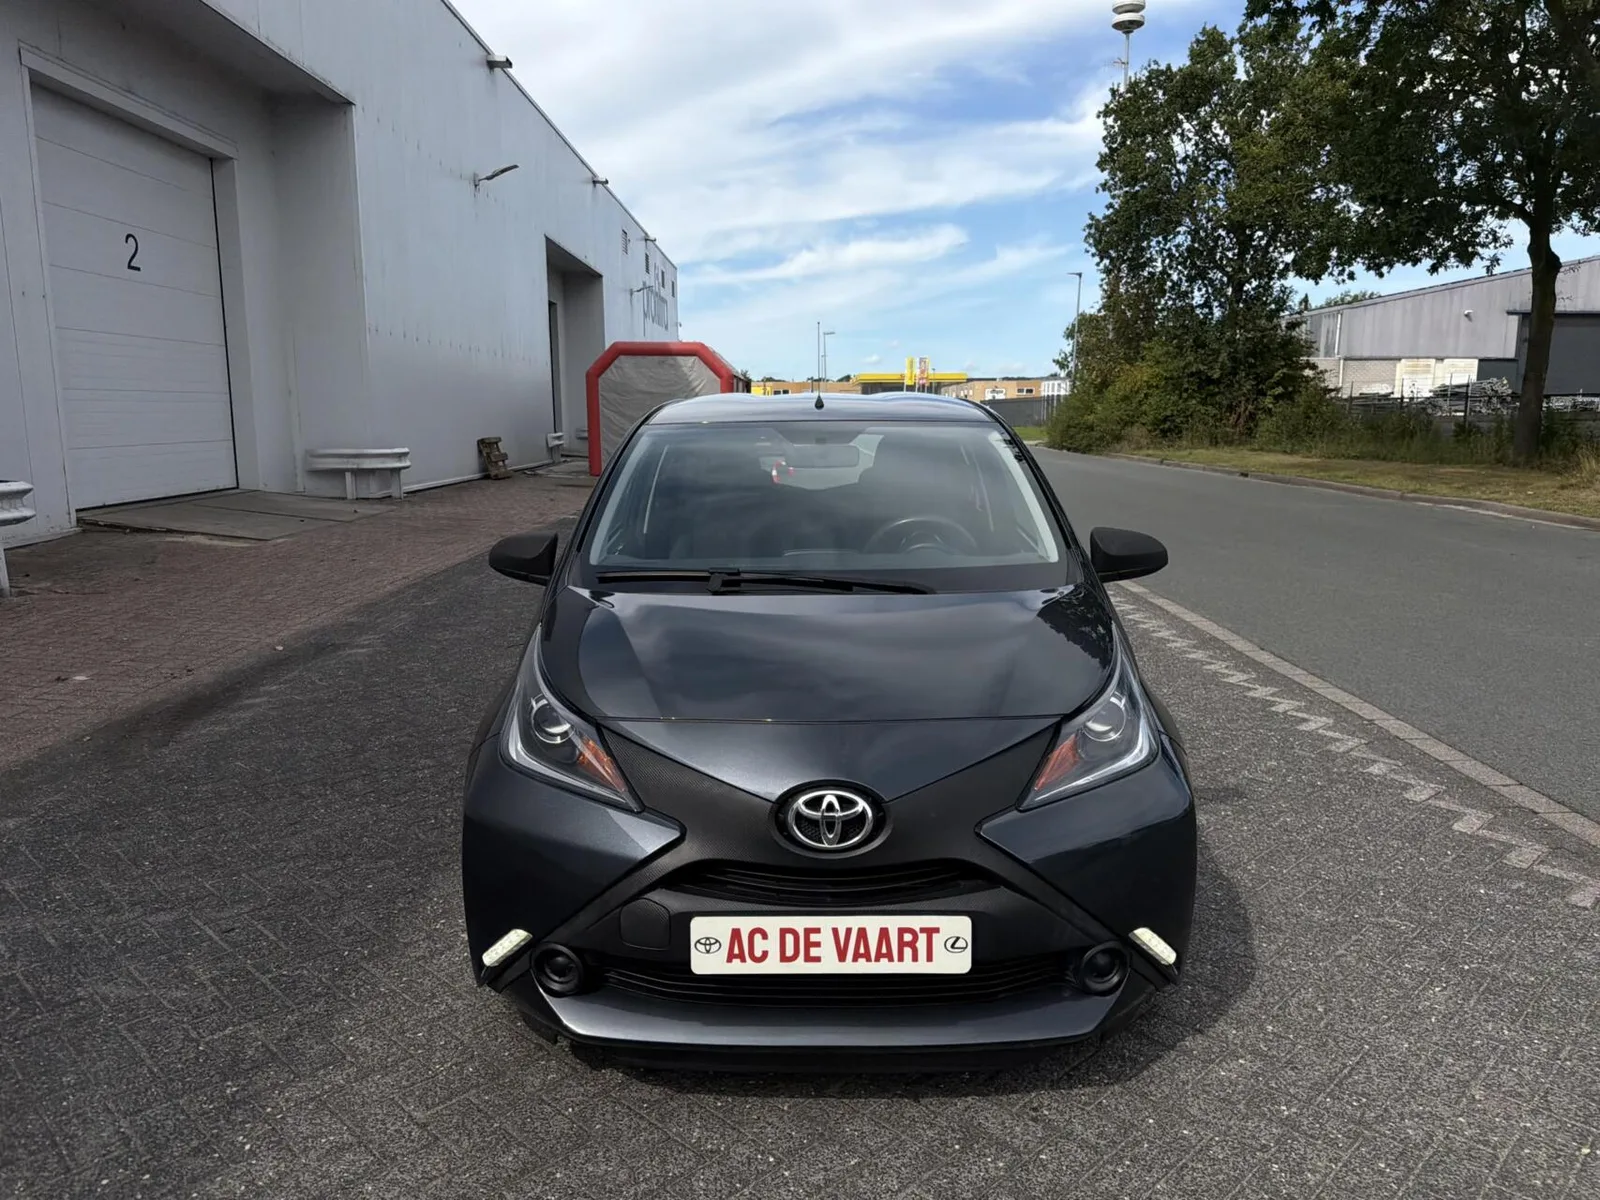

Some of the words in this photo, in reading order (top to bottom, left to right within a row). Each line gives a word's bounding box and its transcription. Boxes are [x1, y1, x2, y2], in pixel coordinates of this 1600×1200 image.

[124, 233, 141, 272] 2
[726, 927, 769, 964] AC
[778, 926, 822, 964] DE
[831, 926, 941, 964] VAART
